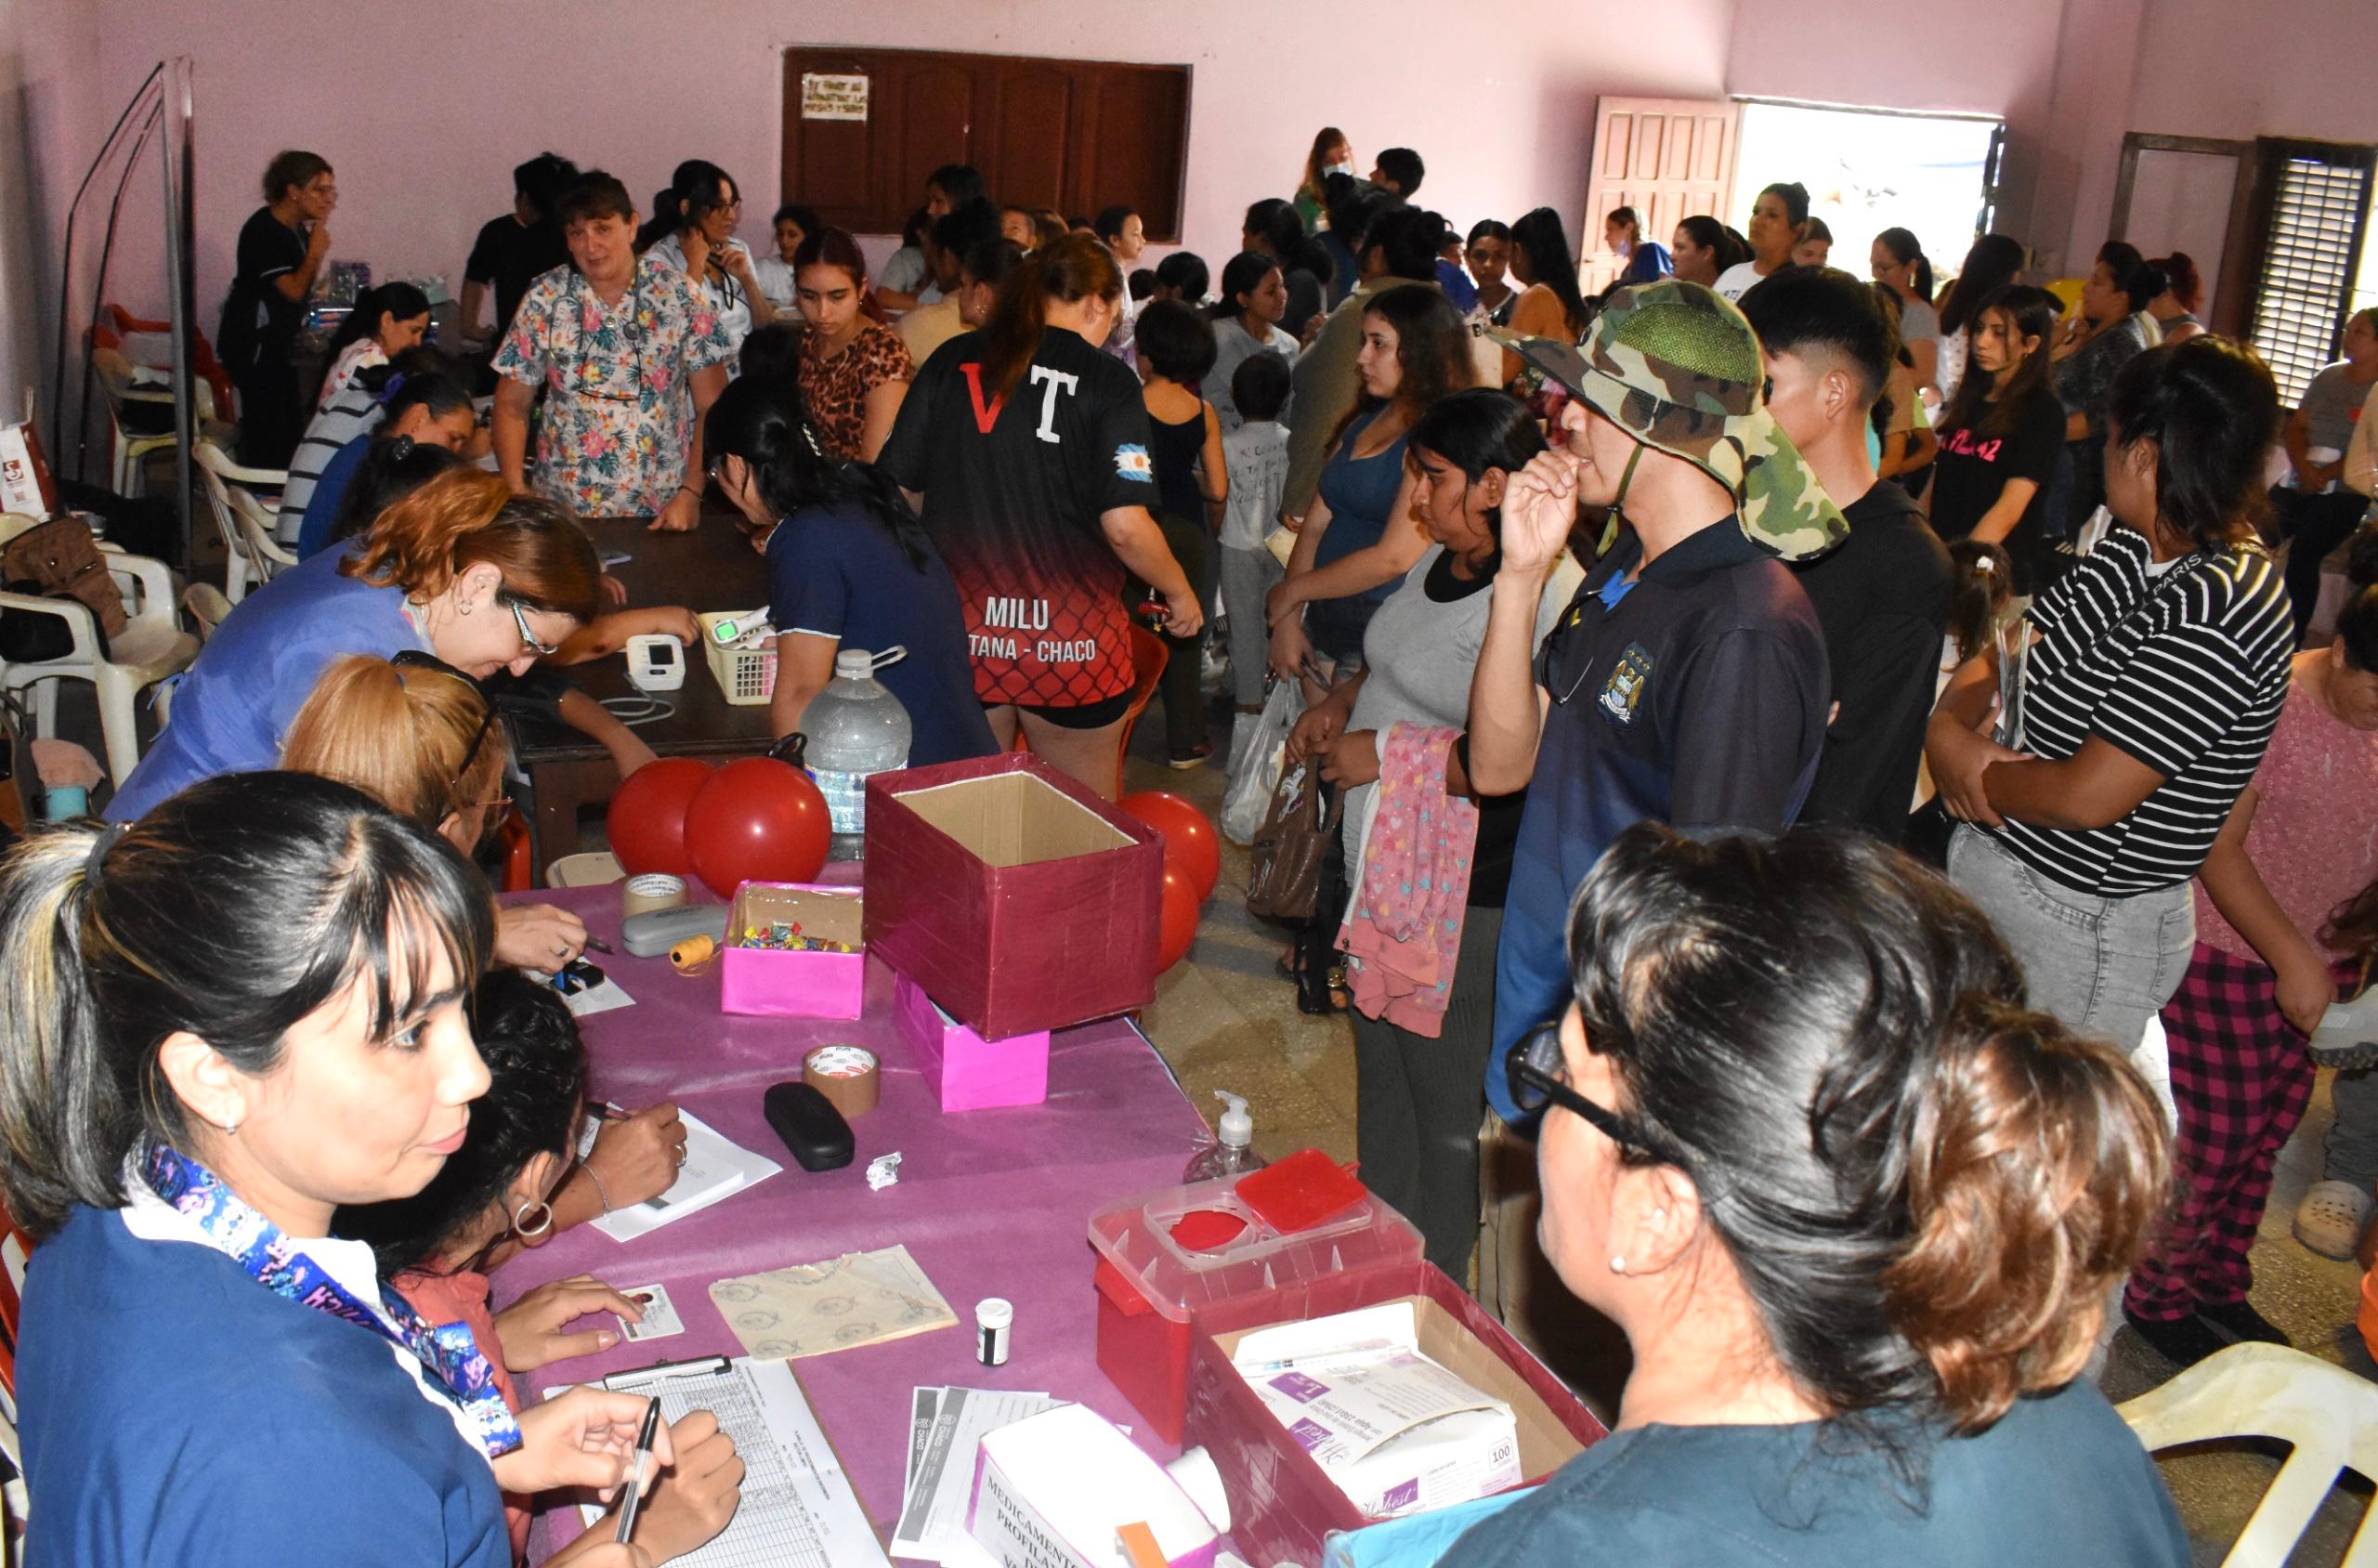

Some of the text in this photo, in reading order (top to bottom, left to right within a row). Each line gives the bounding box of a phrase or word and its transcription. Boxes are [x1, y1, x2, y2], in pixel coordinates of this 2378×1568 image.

[2152, 553, 2202, 595] PARIS
[985, 596, 1050, 631] MILU
[968, 634, 1017, 660] TANA
[1037, 638, 1097, 663] CHACO
[916, 1429, 925, 1450] CHACO
[934, 1426, 947, 1447] CHACO
[1492, 1444, 1510, 1464] 100
[998, 1508, 1055, 1568] PROFILA
